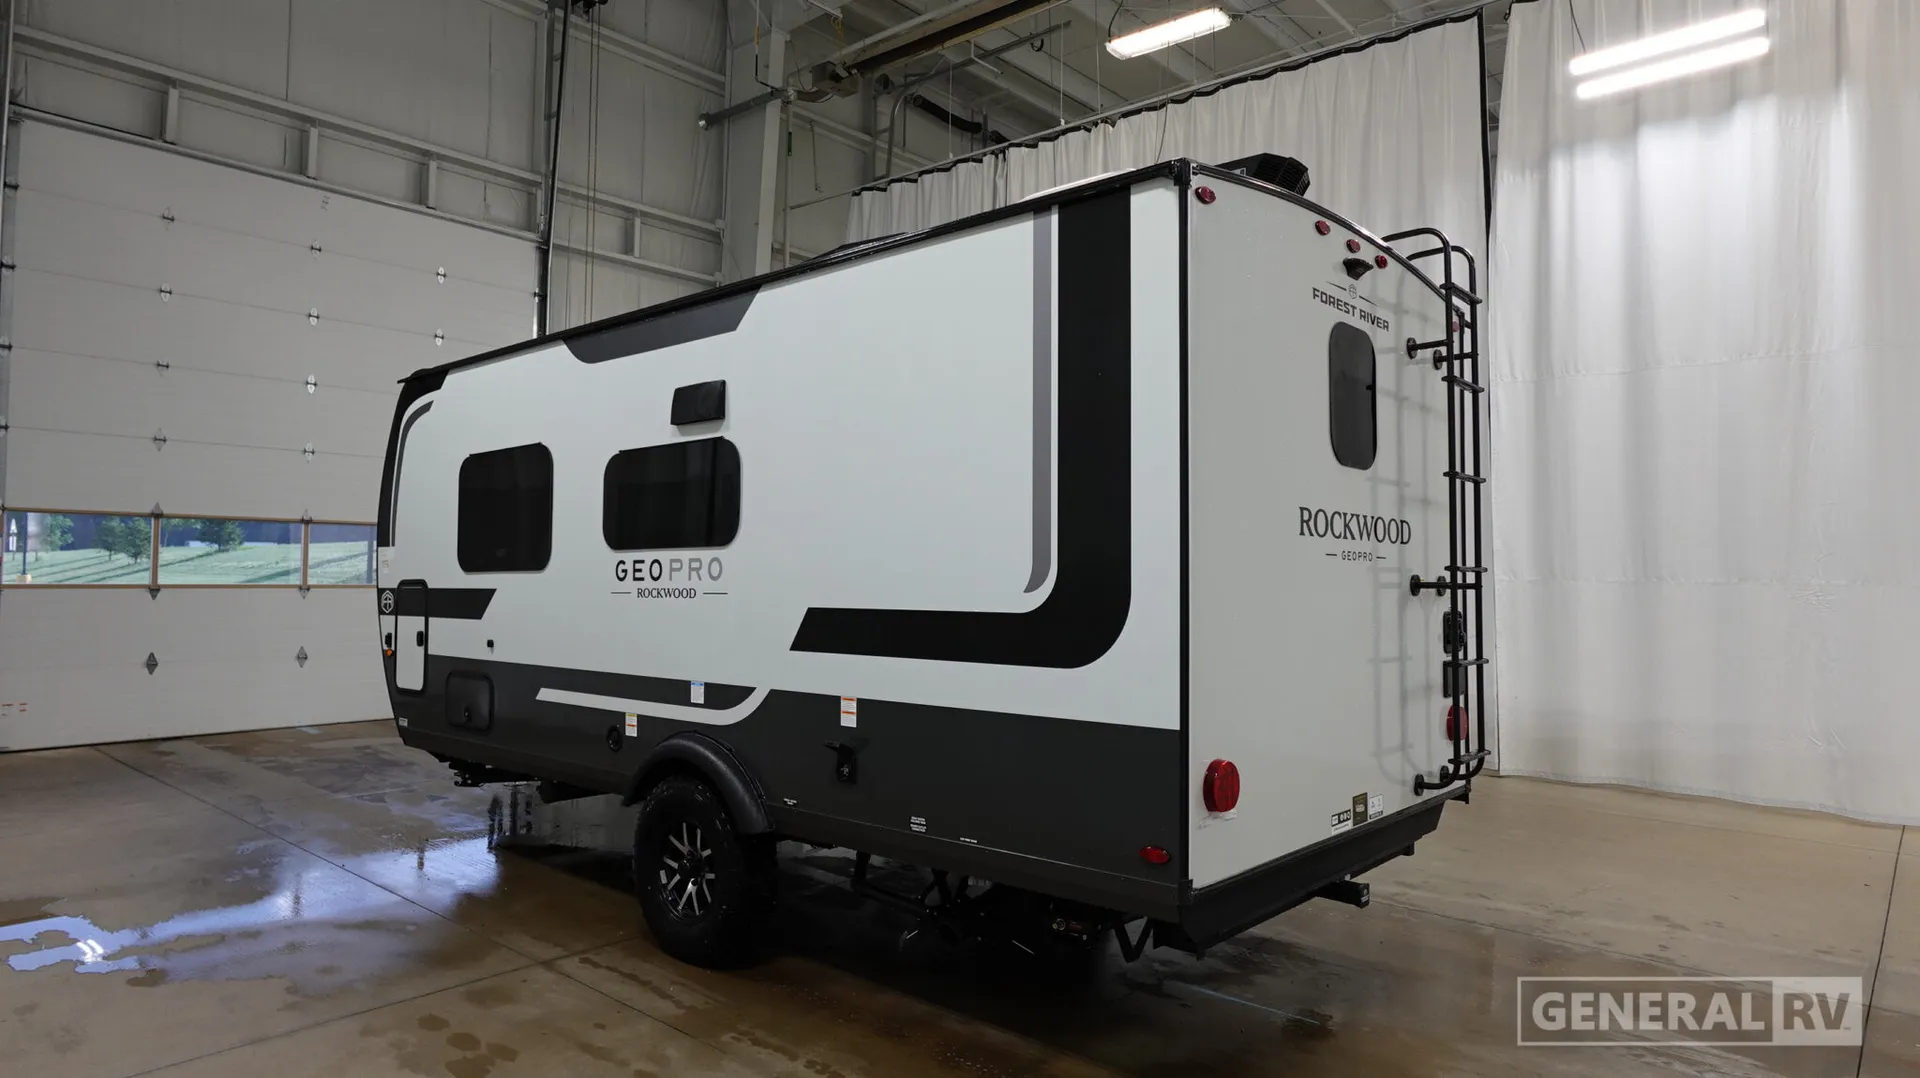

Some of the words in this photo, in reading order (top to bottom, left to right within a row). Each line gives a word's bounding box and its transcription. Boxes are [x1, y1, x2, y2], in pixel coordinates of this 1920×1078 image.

[1312, 286, 1358, 317] FOREST
[1359, 308, 1390, 332] RIVER
[1299, 506, 1412, 545] ROCKWOOD
[615, 556, 723, 582] GEOPRO
[1341, 550, 1373, 562] GEOPRO
[636, 587, 697, 599] ROCKWOOD
